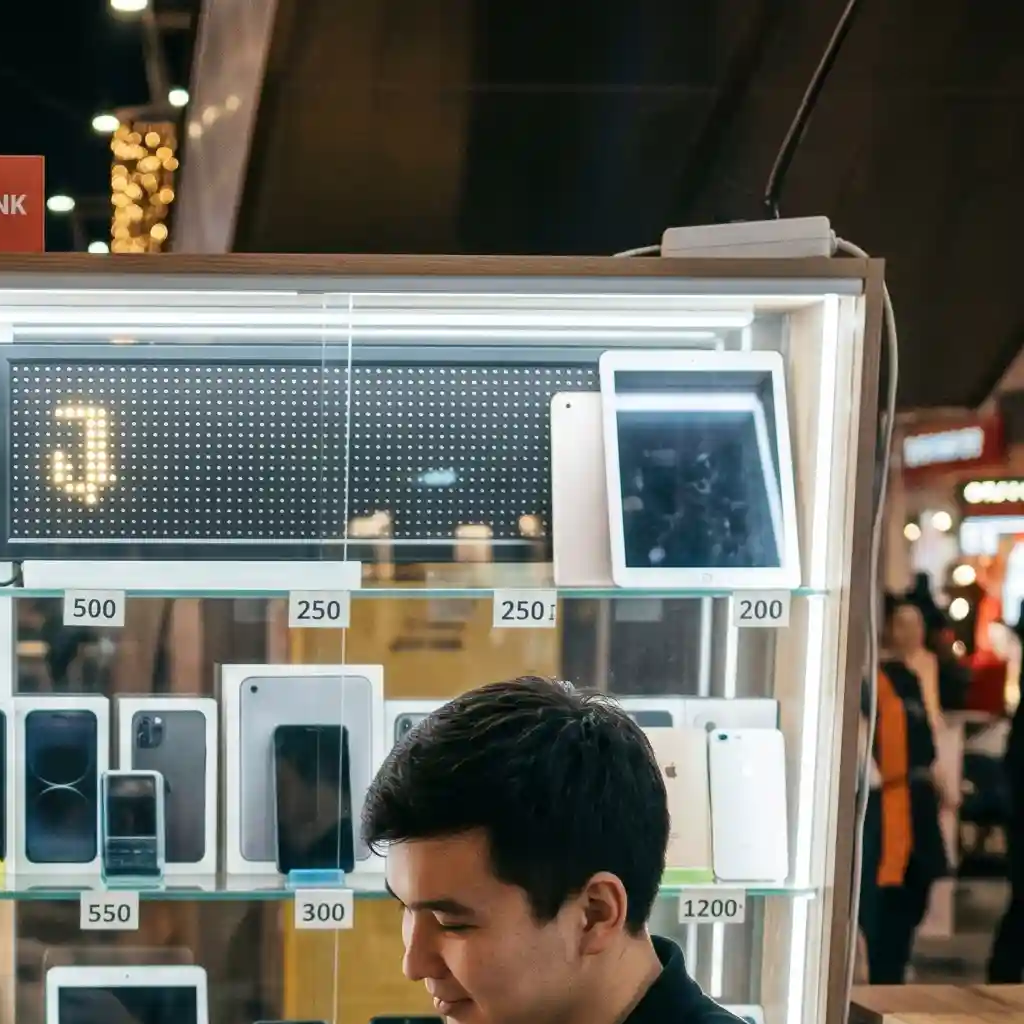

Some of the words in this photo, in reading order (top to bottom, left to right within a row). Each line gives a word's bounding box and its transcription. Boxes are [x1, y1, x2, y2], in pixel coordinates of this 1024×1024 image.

[73, 599, 116, 619] 500
[297, 600, 341, 620] 250
[739, 600, 783, 620] 200
[88, 904, 131, 923] 550
[302, 903, 345, 922] 300
[684, 899, 737, 918] 1200
